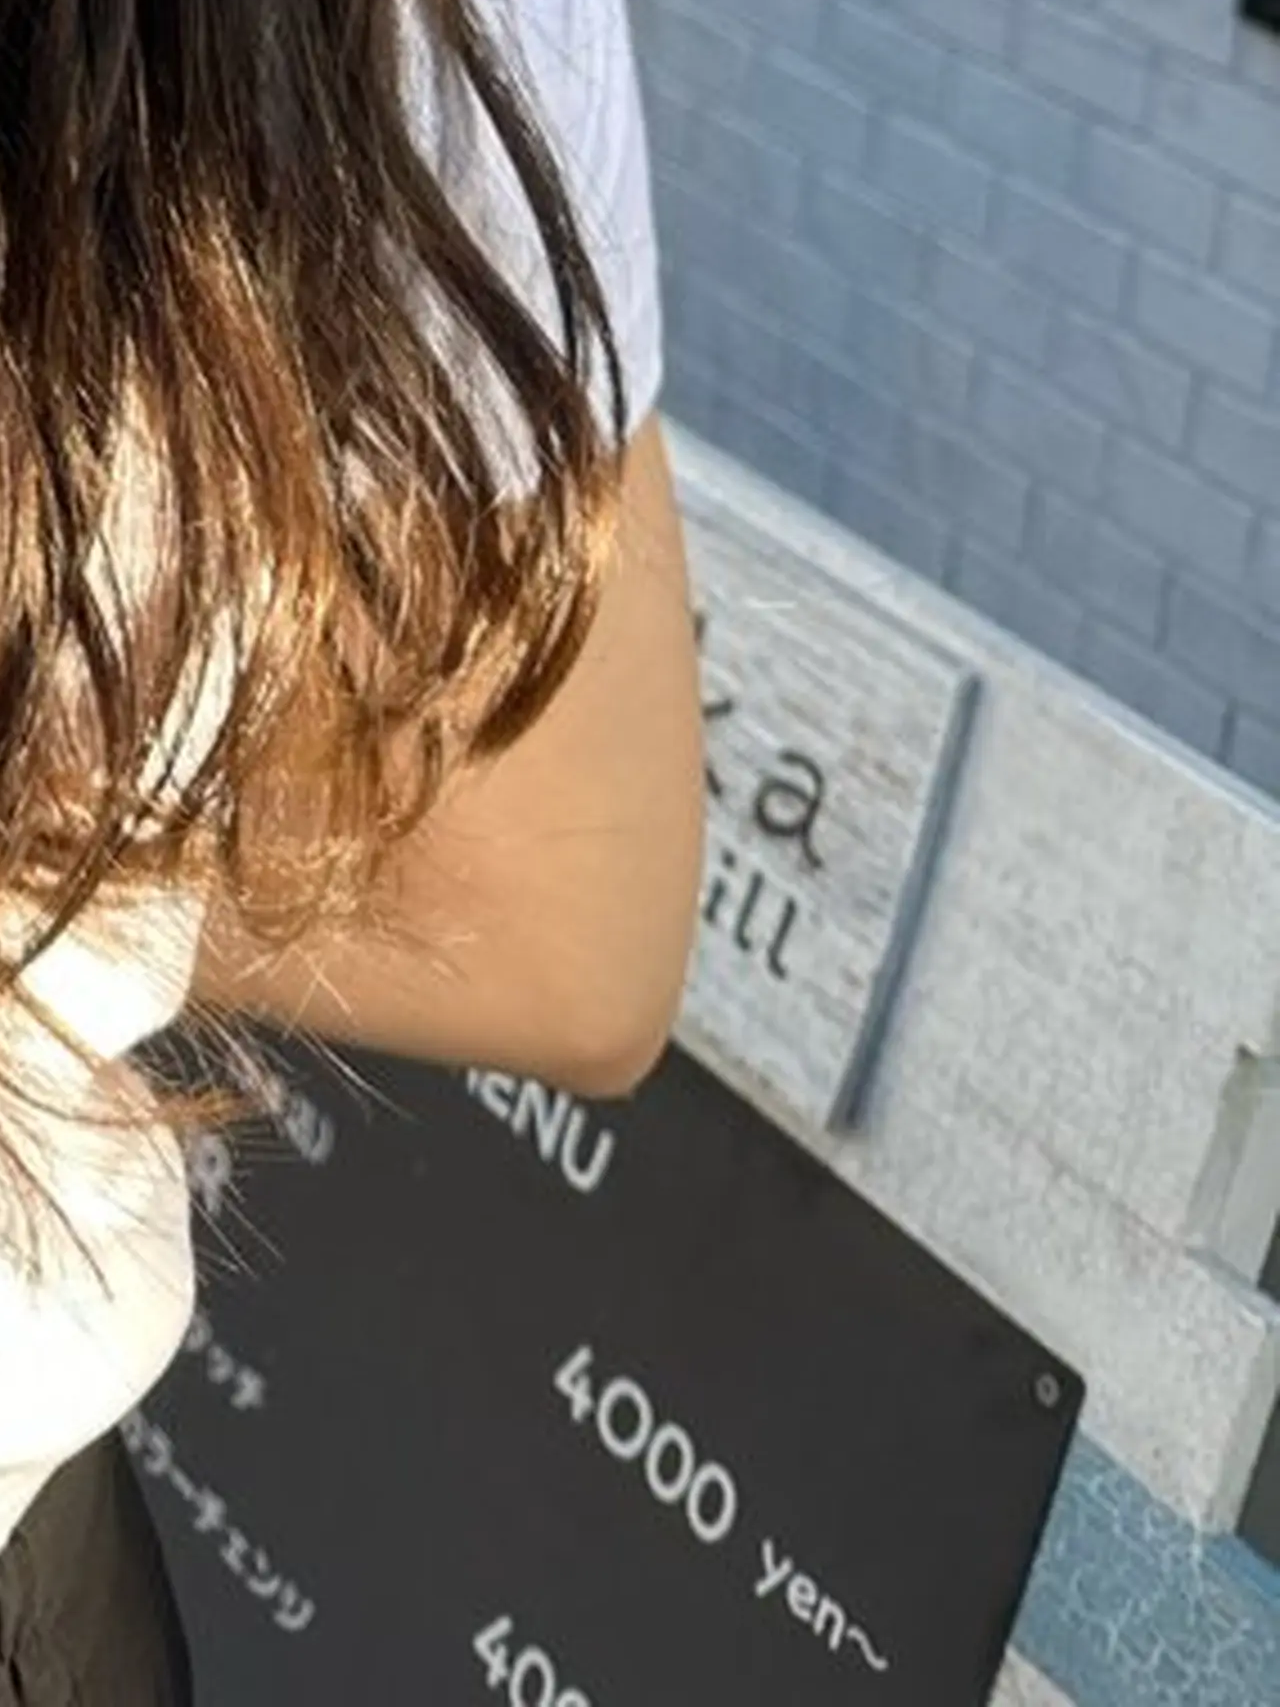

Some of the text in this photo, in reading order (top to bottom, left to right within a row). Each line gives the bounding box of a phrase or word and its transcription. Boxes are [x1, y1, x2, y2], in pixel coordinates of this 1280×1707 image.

[466, 1066, 616, 1195] ENU
[552, 1344, 737, 1544] 4000
[471, 1615, 593, 1707] 40
